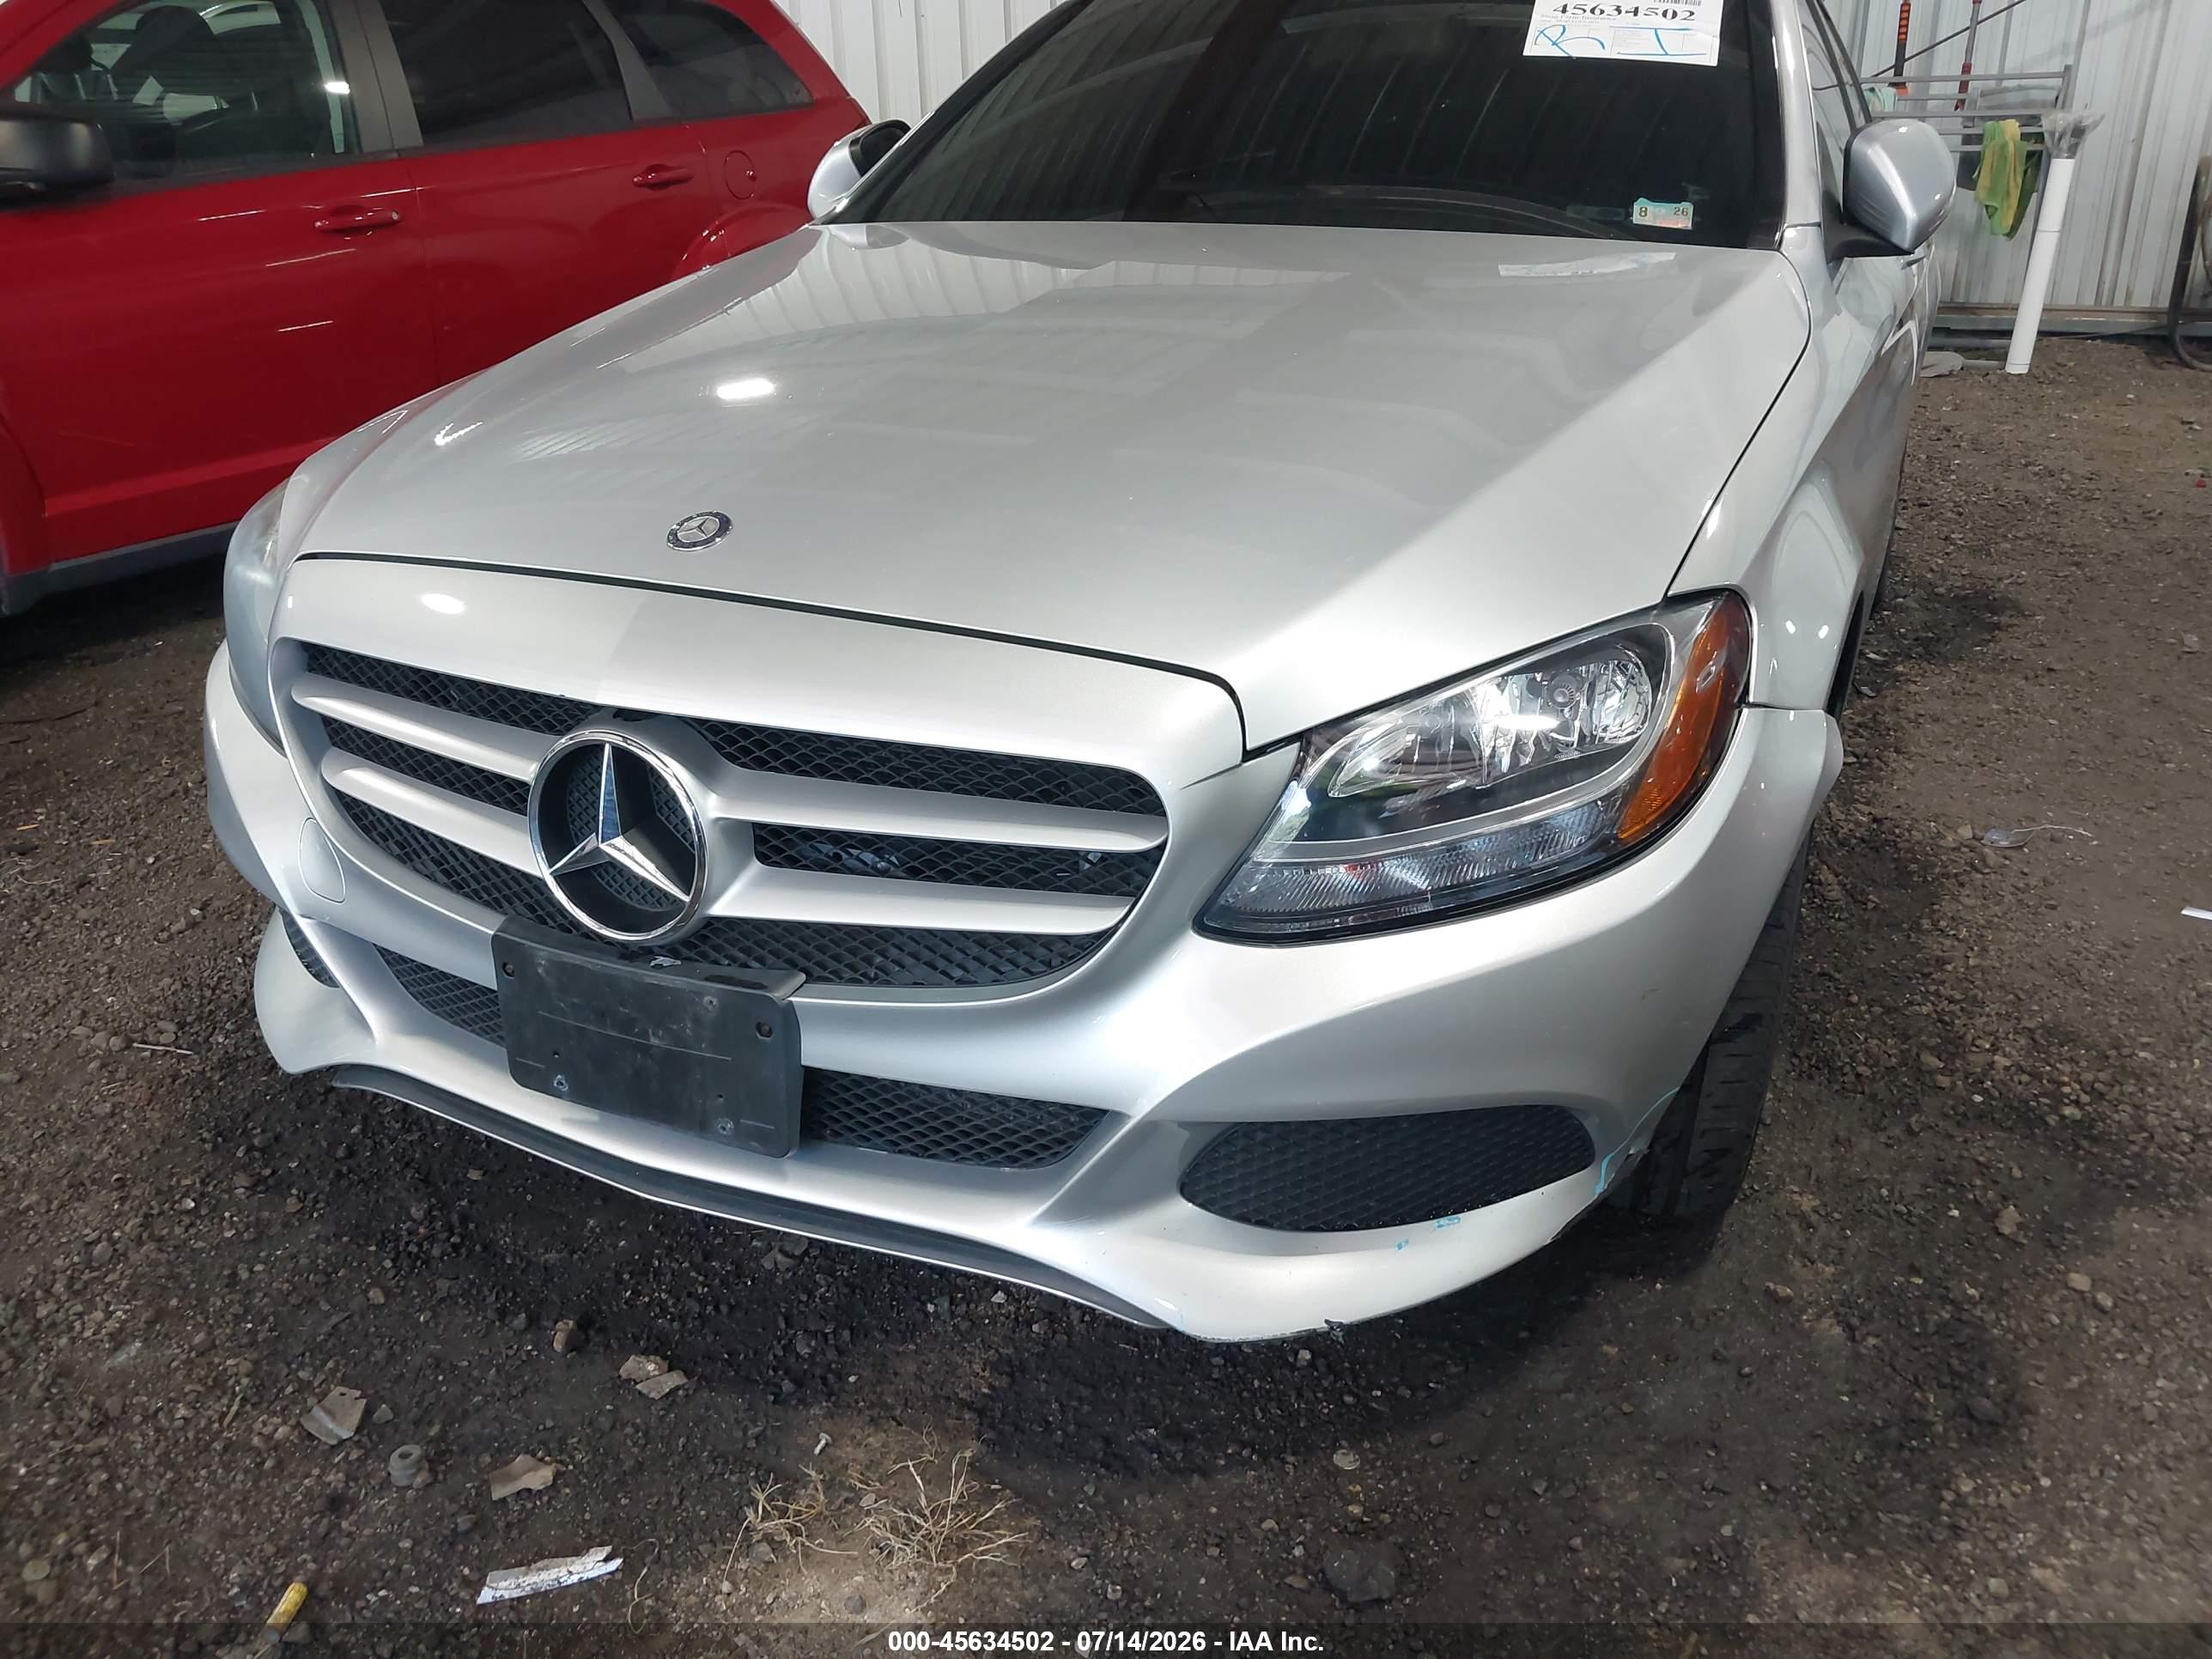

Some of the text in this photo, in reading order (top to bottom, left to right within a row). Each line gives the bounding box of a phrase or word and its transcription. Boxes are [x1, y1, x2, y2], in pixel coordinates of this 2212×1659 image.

[1553, 3, 1697, 21] 45634502
[1638, 206, 1689, 218] 8 26
